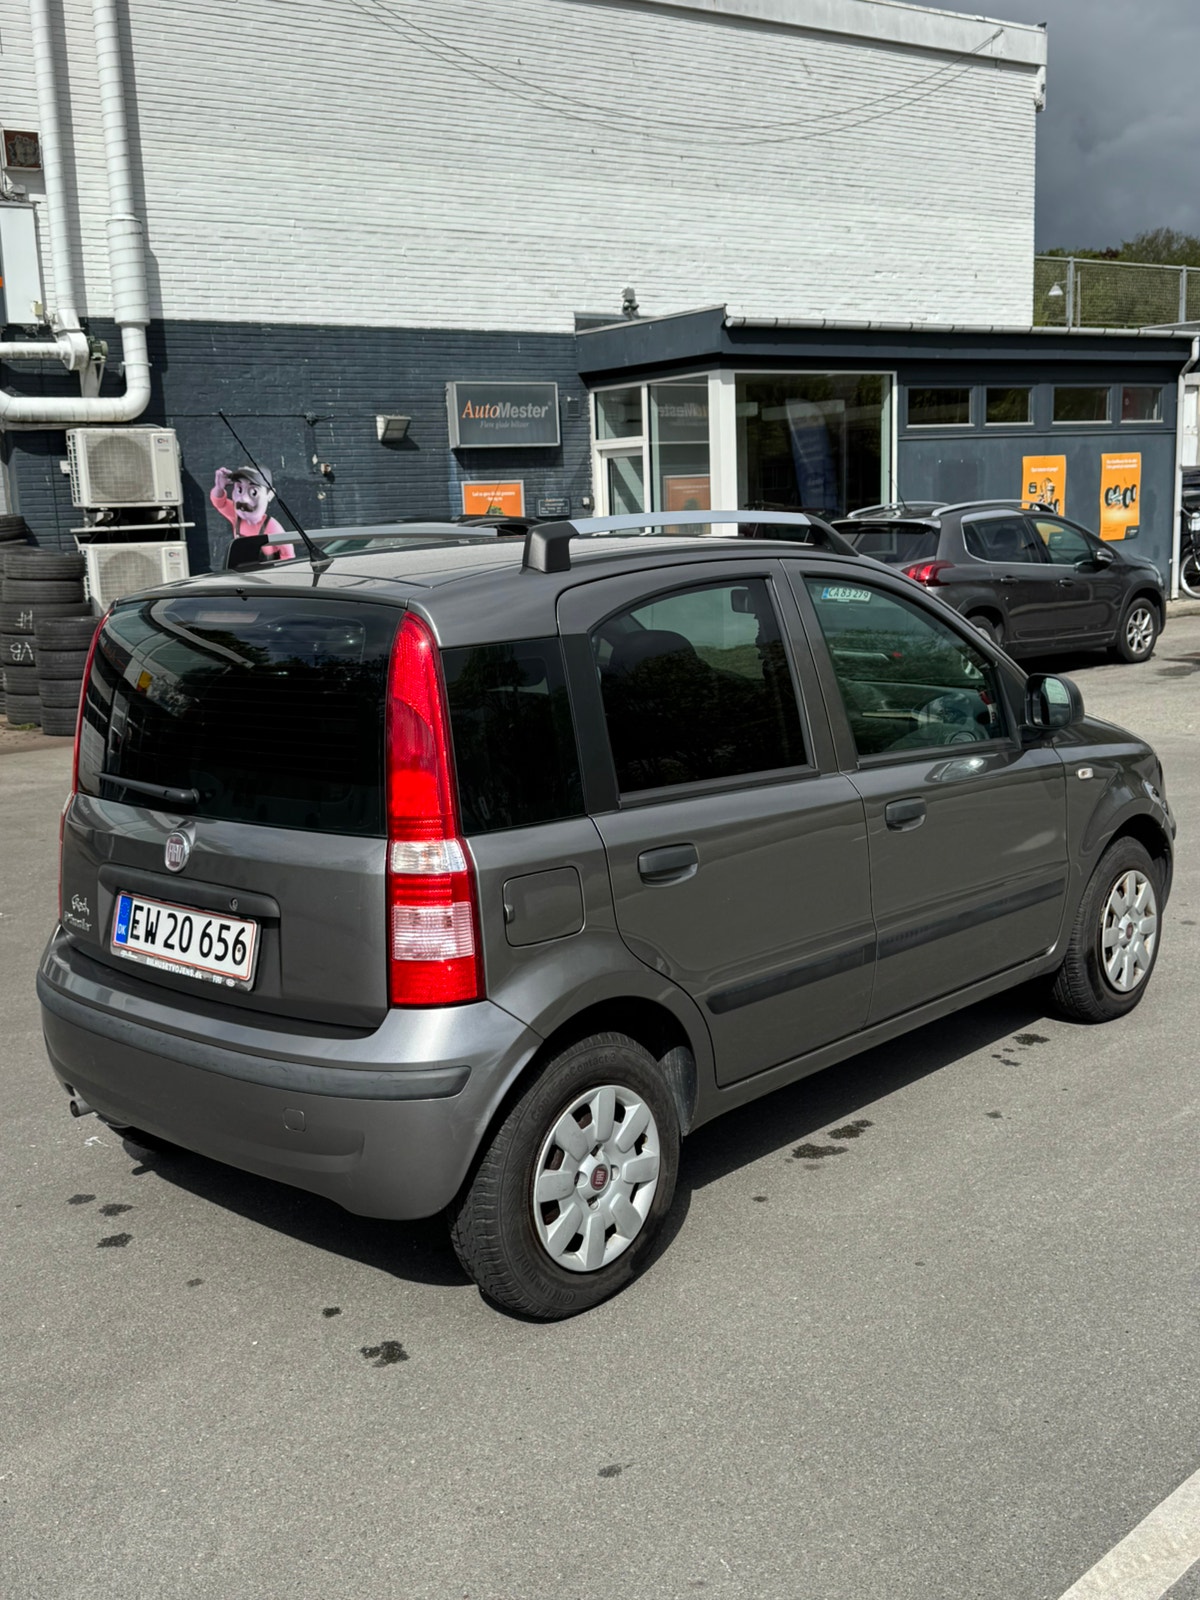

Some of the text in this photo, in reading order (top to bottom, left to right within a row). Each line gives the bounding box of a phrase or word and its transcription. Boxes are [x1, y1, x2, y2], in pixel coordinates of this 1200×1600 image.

[462, 400, 548, 419] AutoMester
[828, 587, 870, 599] CA 83 279
[117, 923, 127, 936] DK
[130, 904, 247, 966] EW 20 656
